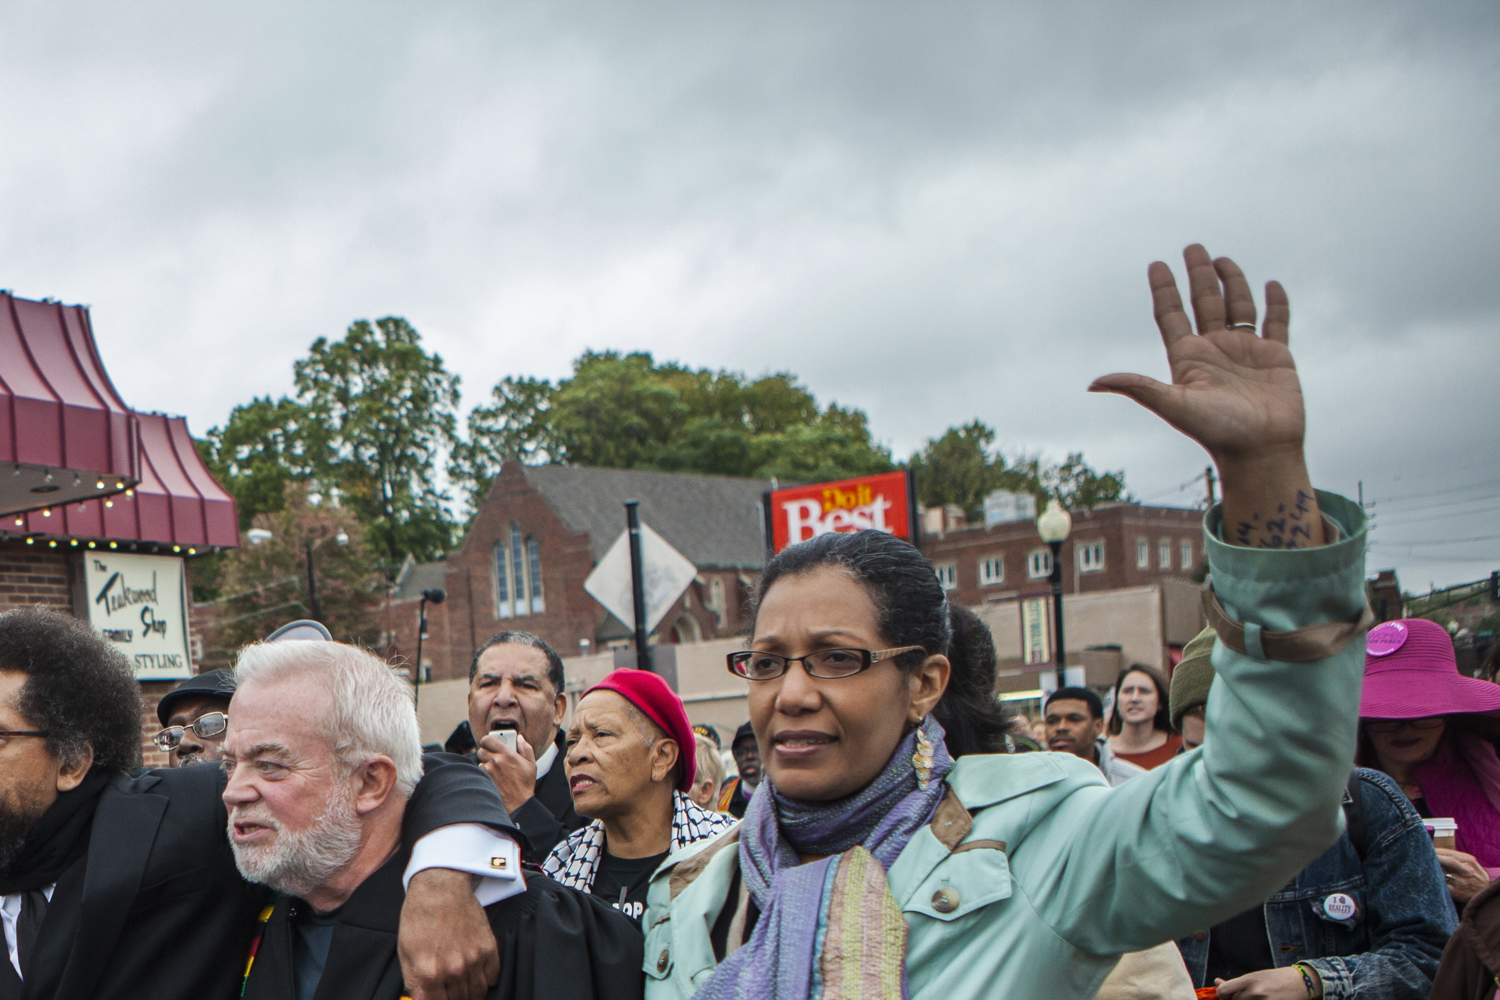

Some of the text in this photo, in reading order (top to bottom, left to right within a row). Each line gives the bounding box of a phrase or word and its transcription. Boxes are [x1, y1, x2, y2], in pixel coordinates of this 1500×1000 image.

[822, 484, 873, 512] Do it
[782, 493, 893, 548] Best
[93, 559, 107, 572] The
[96, 570, 158, 616] Teakwood
[140, 605, 167, 639] Shop
[134, 653, 183, 669] STYLING
[1328, 904, 1352, 913] REALITY
